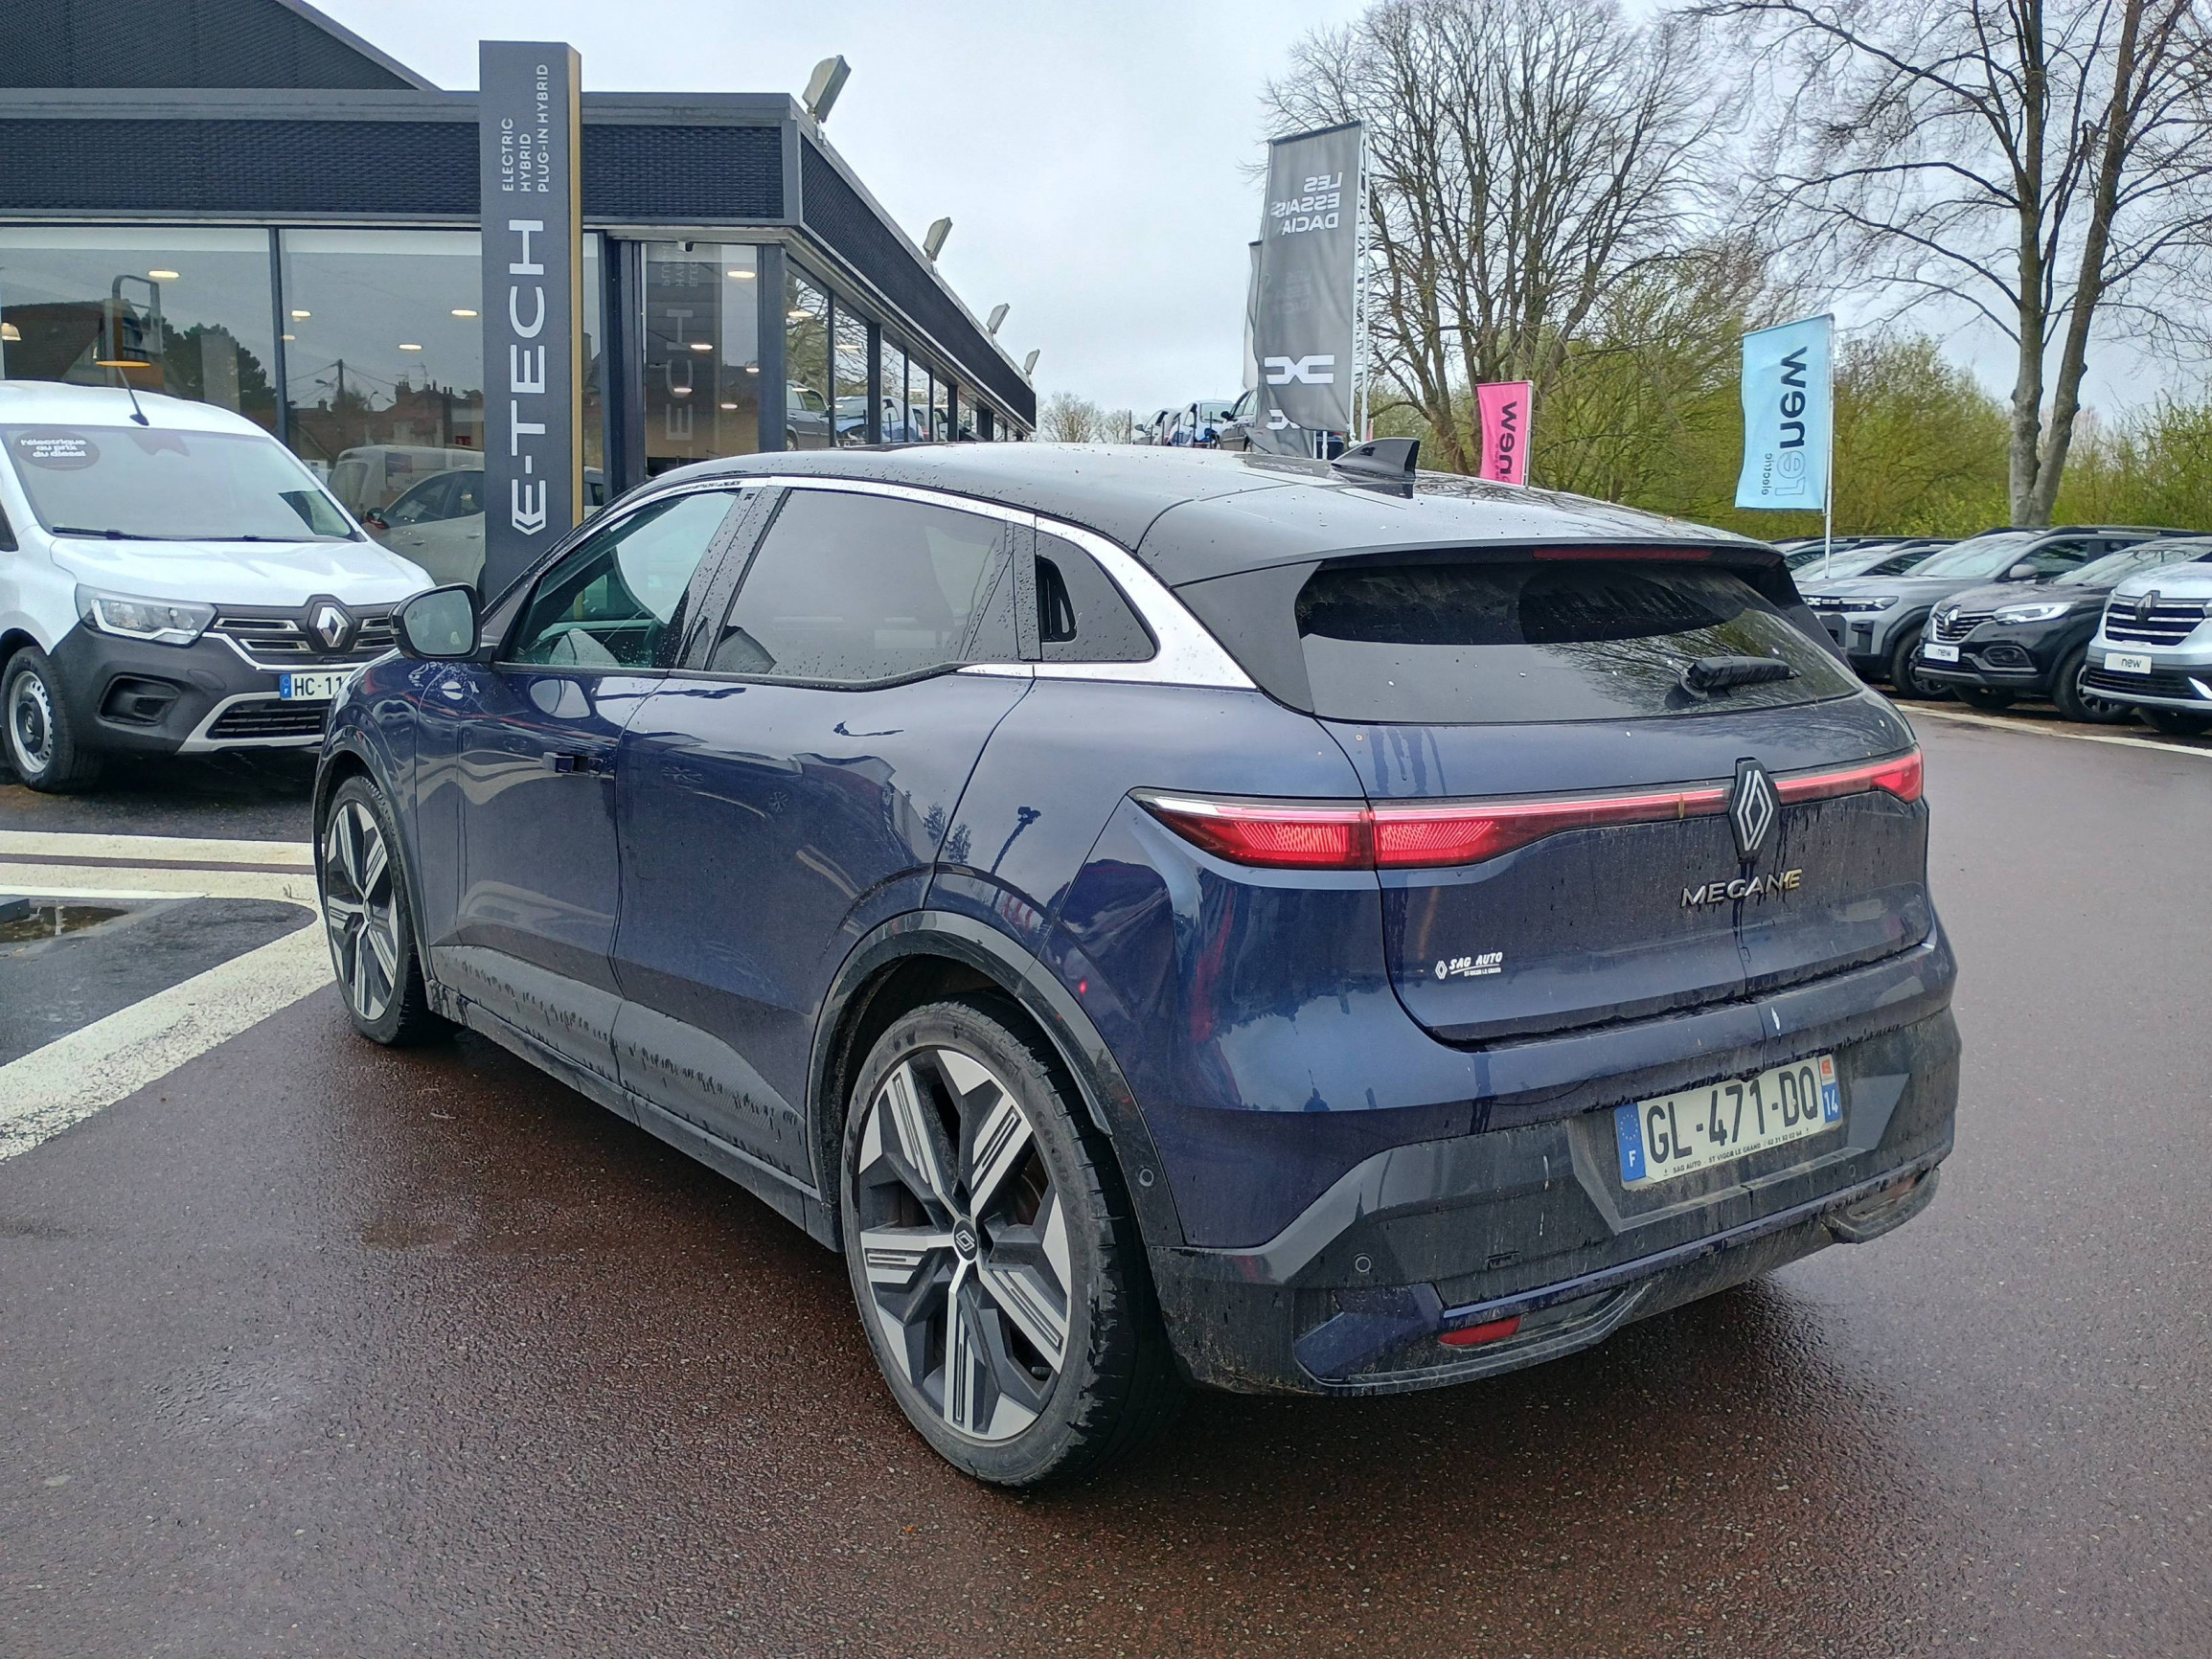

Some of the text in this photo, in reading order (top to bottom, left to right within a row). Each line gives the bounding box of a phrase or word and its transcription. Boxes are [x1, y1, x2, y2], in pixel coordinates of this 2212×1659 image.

[501, 117, 514, 192] ELECTRIC
[536, 64, 550, 193] PLUG-IN HYBRID
[519, 133, 532, 193] HYBRID
[509, 219, 546, 535] E-TECH
[2120, 657, 2142, 669] new
[1681, 869, 1803, 908] MEGANE
[1448, 952, 1503, 970] SAG AUTO
[1628, 1065, 1838, 1168] F GL-471-DQ 14
[1673, 1163, 1685, 1174] SAG
[1686, 1160, 1701, 1170] AUTO
[1717, 1149, 1735, 1162] VIGOR
[1735, 1148, 1743, 1156] LE
[1743, 1143, 1762, 1153] GRAND
